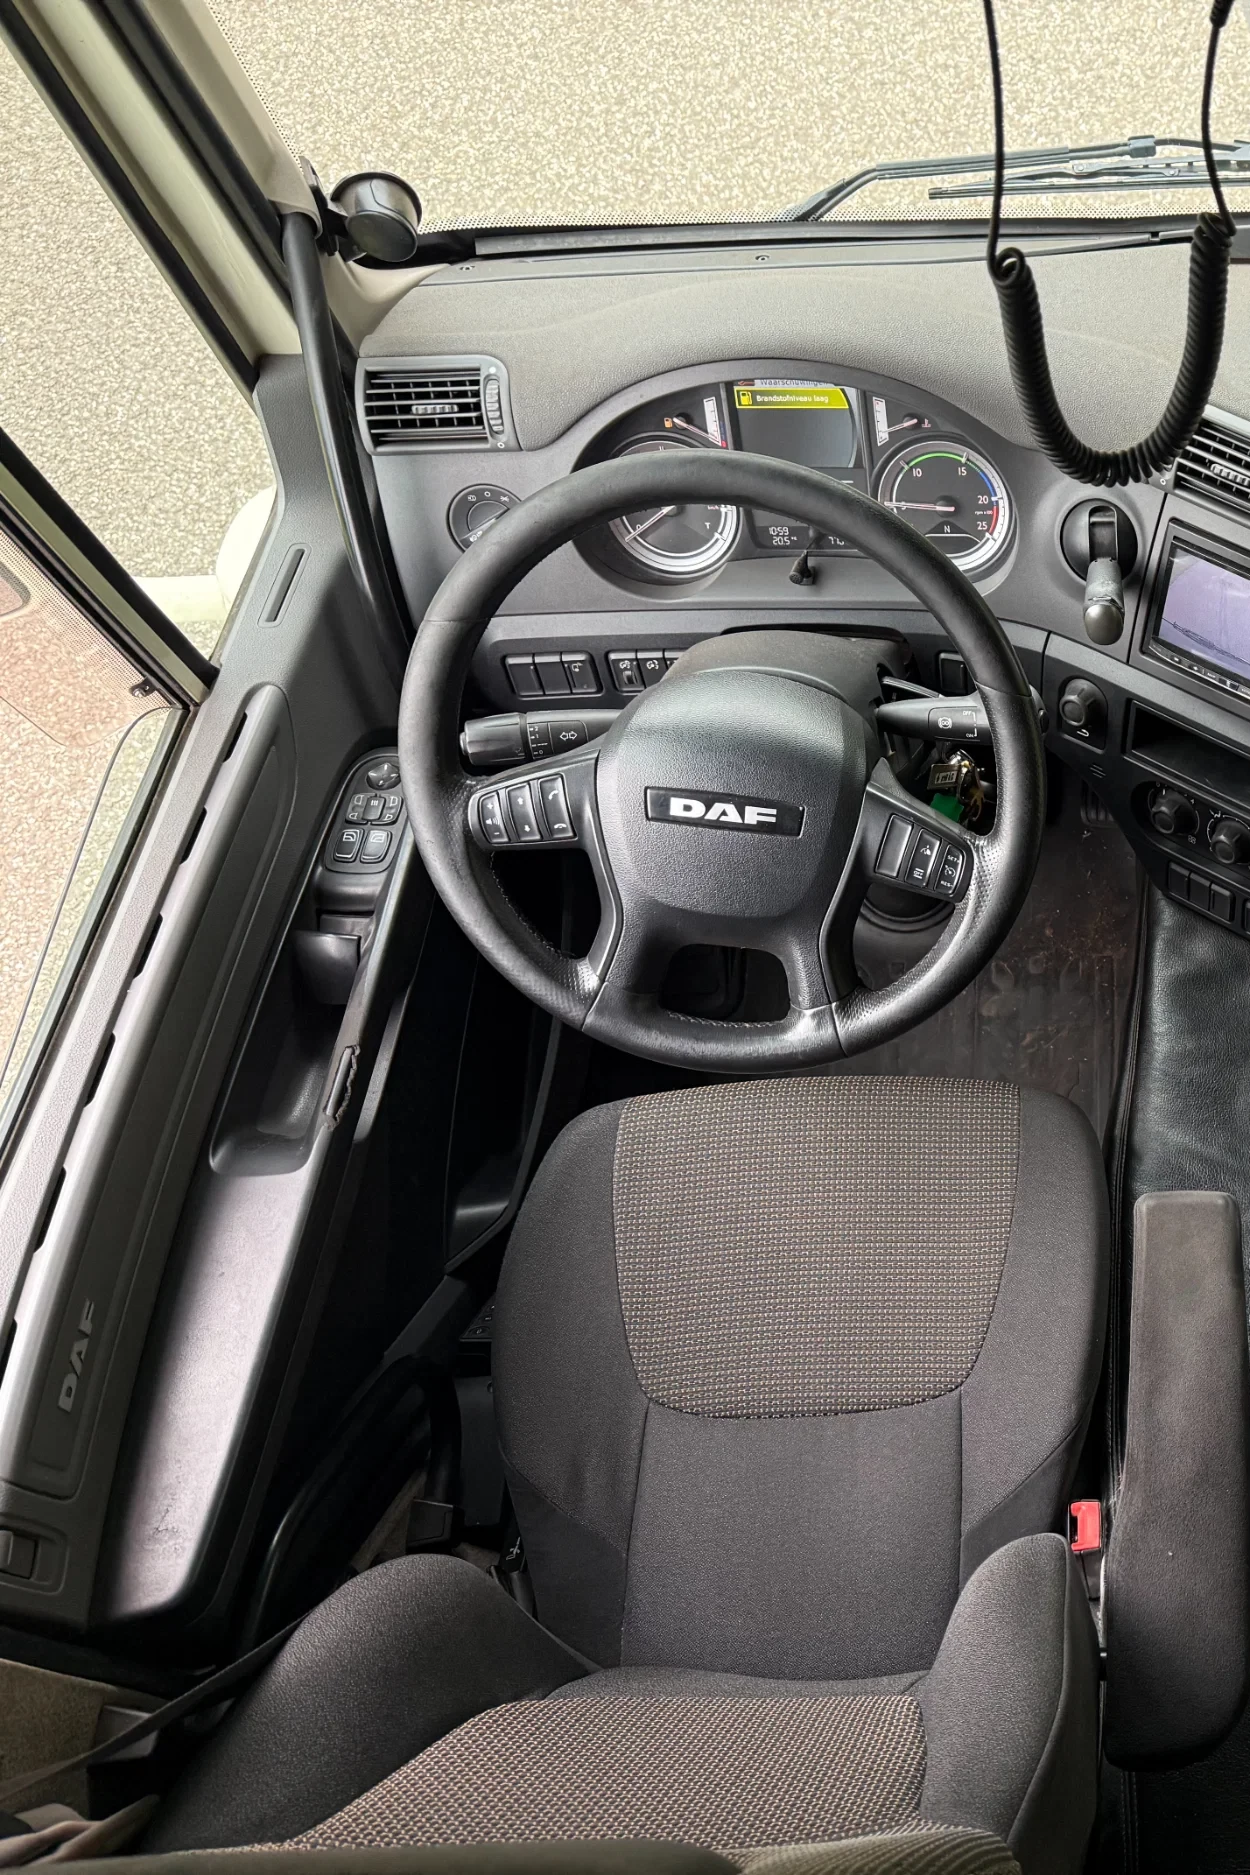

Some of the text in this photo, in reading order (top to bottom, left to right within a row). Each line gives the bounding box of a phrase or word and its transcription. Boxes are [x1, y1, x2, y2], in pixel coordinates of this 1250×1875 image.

[756, 394, 829, 403] Brandstofniveau laag
[912, 468, 923, 477] 10
[957, 466, 967, 476] 15
[976, 495, 989, 504] 20
[943, 524, 951, 534] N
[976, 521, 988, 530] 25
[669, 797, 777, 825] DAF
[57, 1298, 95, 1413] DAF
